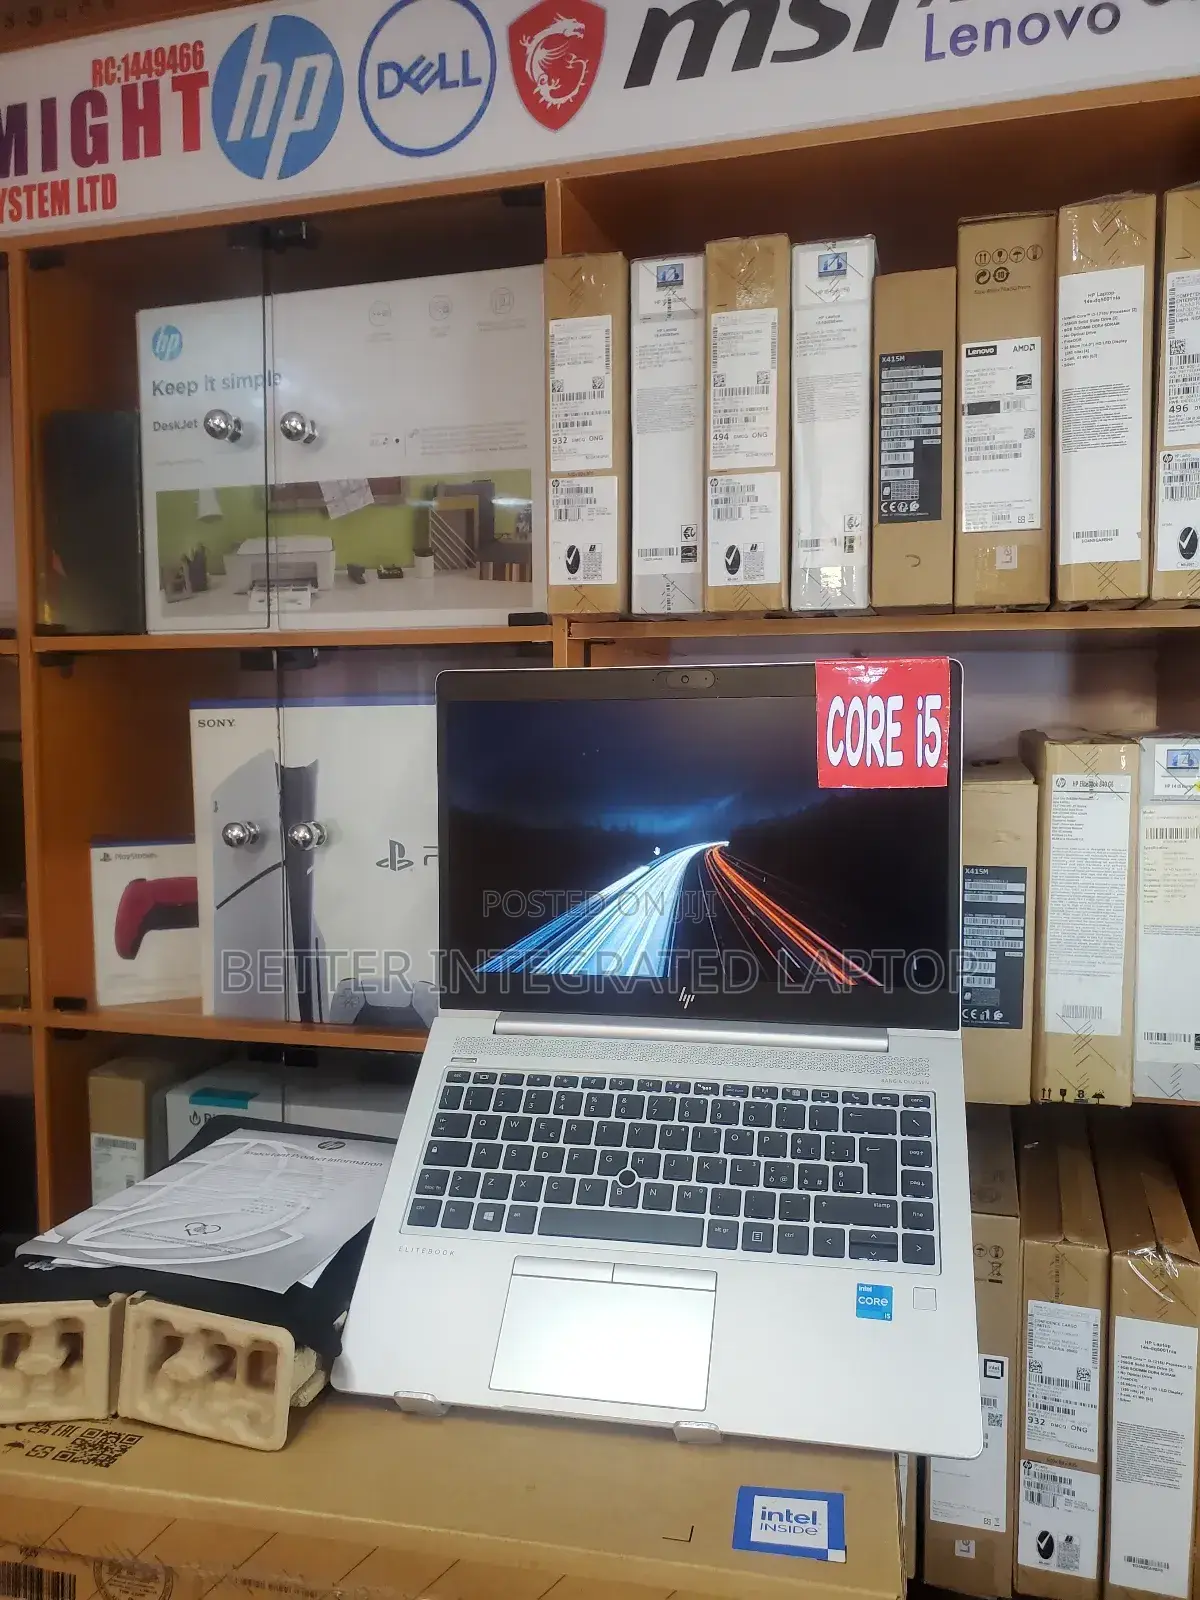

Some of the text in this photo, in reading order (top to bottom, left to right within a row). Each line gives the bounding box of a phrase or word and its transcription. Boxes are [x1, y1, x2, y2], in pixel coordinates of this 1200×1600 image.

[924, 4, 1122, 62] Lenovo
[91, 40, 205, 88] RC:1449466
[377, 48, 482, 100] DELL
[228, 15, 333, 180] hp
[77, 172, 118, 214] LTD
[967, 344, 1030, 356] Lenovo AMD
[152, 380, 199, 397] Keep
[221, 369, 282, 392] simple
[1168, 403, 1189, 413] 496
[153, 419, 198, 432] DeskJet
[552, 437, 568, 445] 932
[712, 433, 729, 441] 494
[752, 431, 768, 439] ONG
[197, 718, 236, 728] SONY
[826, 694, 943, 768] CORE i5
[510, 1120, 520, 1128] W
[665, 1129, 672, 1137] U
[763, 1136, 770, 1144] P
[243, 1150, 290, 1159] Important
[290, 1152, 326, 1163] Product
[510, 1149, 517, 1157] S
[669, 1159, 676, 1167] J
[703, 1161, 710, 1169] K
[487, 1178, 495, 1186] Z
[519, 1180, 527, 1188] X
[551, 1182, 559, 1190] C
[616, 1188, 623, 1196] B
[649, 1188, 657, 1196] N
[683, 1191, 692, 1199] M
[398, 1245, 456, 1257] ELITEBOOK
[1027, 1416, 1046, 1426] 932
[1070, 1424, 1088, 1434] ONG
[760, 1505, 818, 1526] intel
